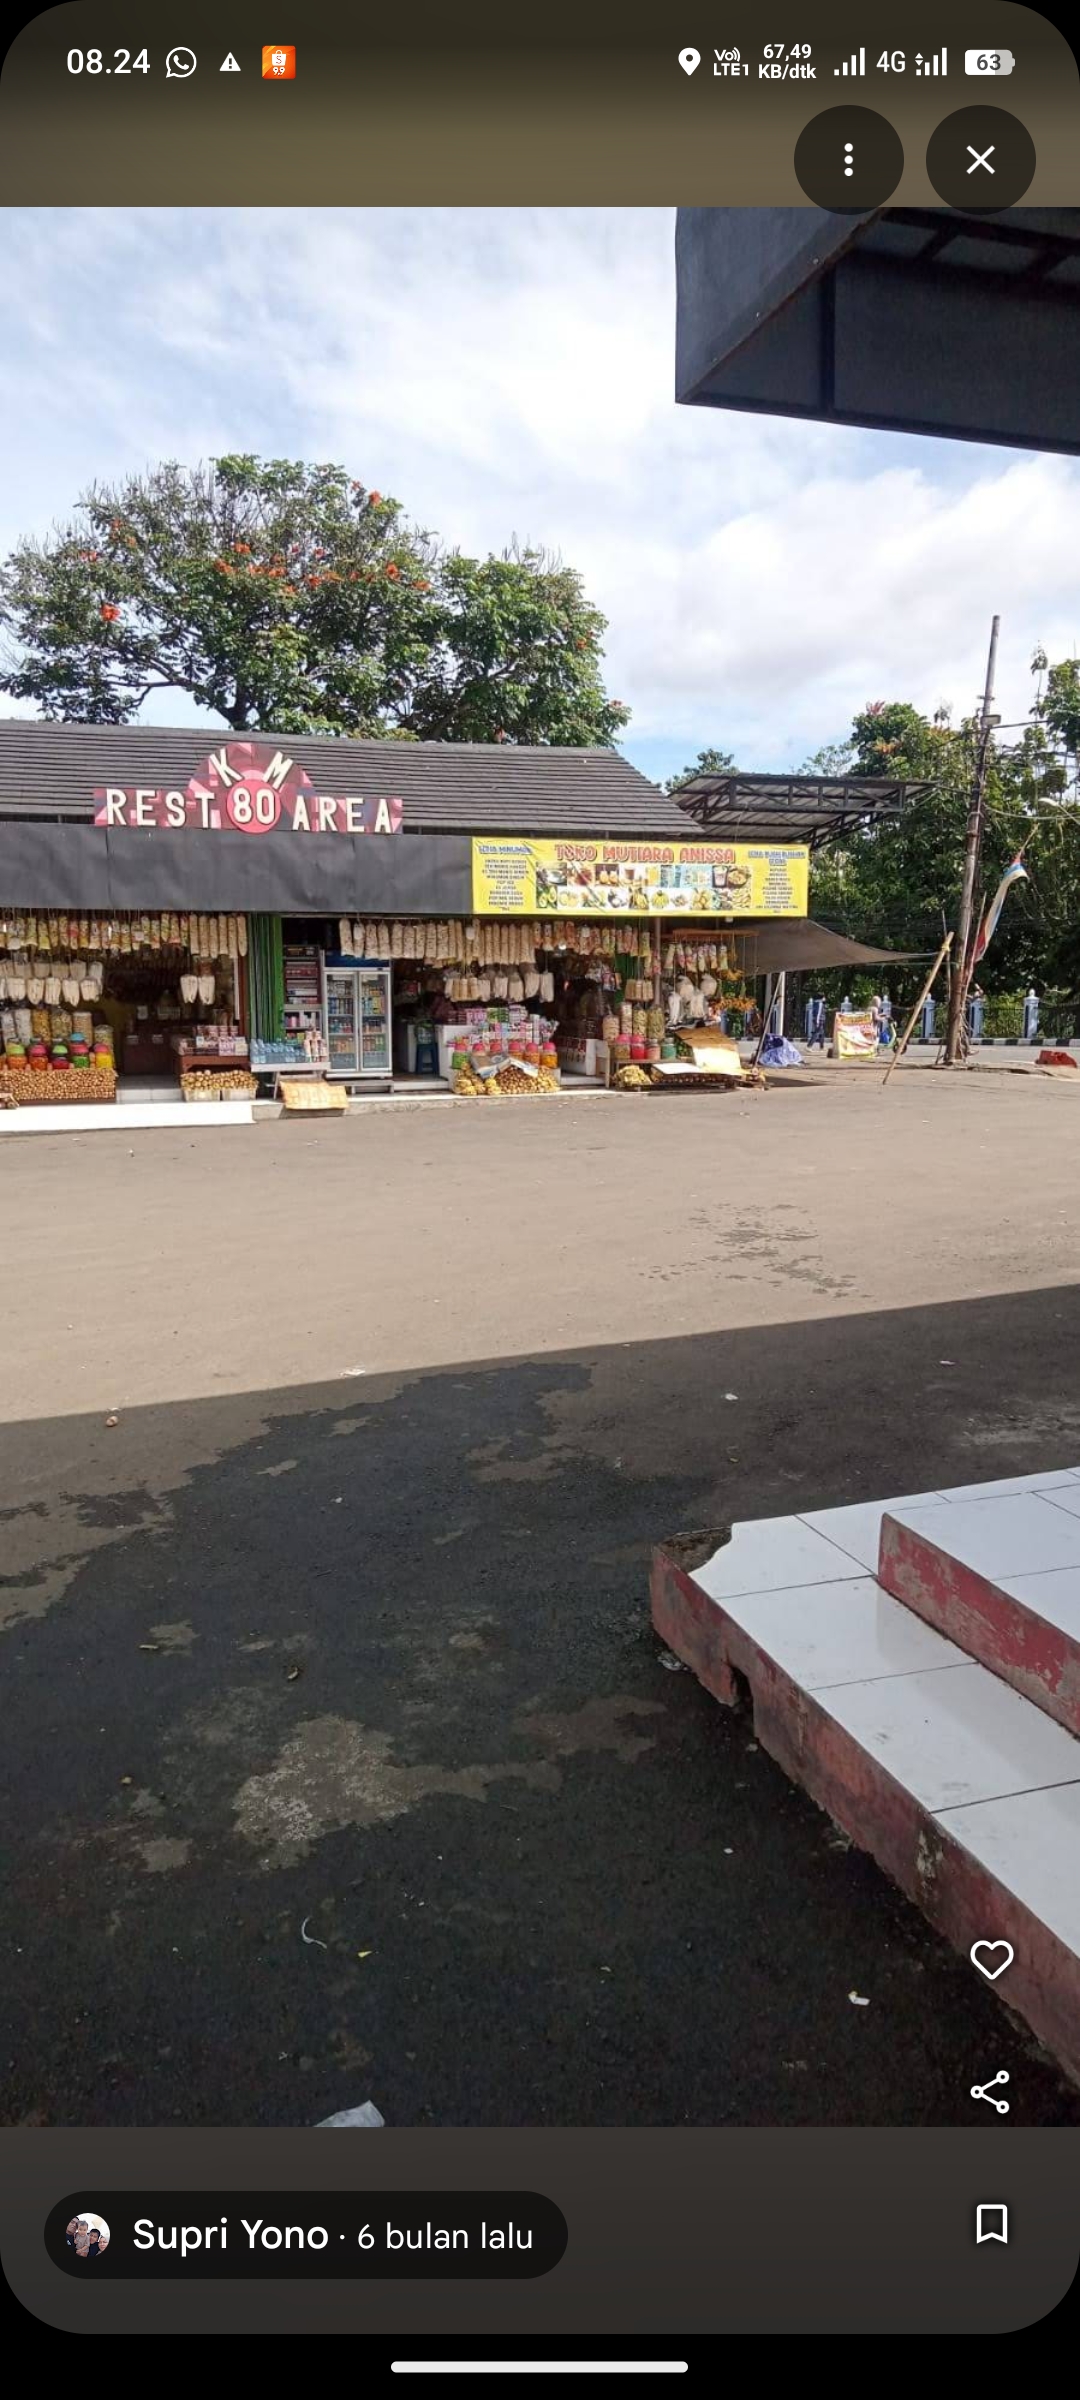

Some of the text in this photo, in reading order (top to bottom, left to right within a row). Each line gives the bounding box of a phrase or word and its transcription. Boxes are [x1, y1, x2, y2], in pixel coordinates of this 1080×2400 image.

[106, 787, 394, 833] REST 80 AREA
[554, 844, 597, 862] TOKO
[603, 846, 674, 863] MUTIARA
[679, 847, 736, 864] ANISSA
